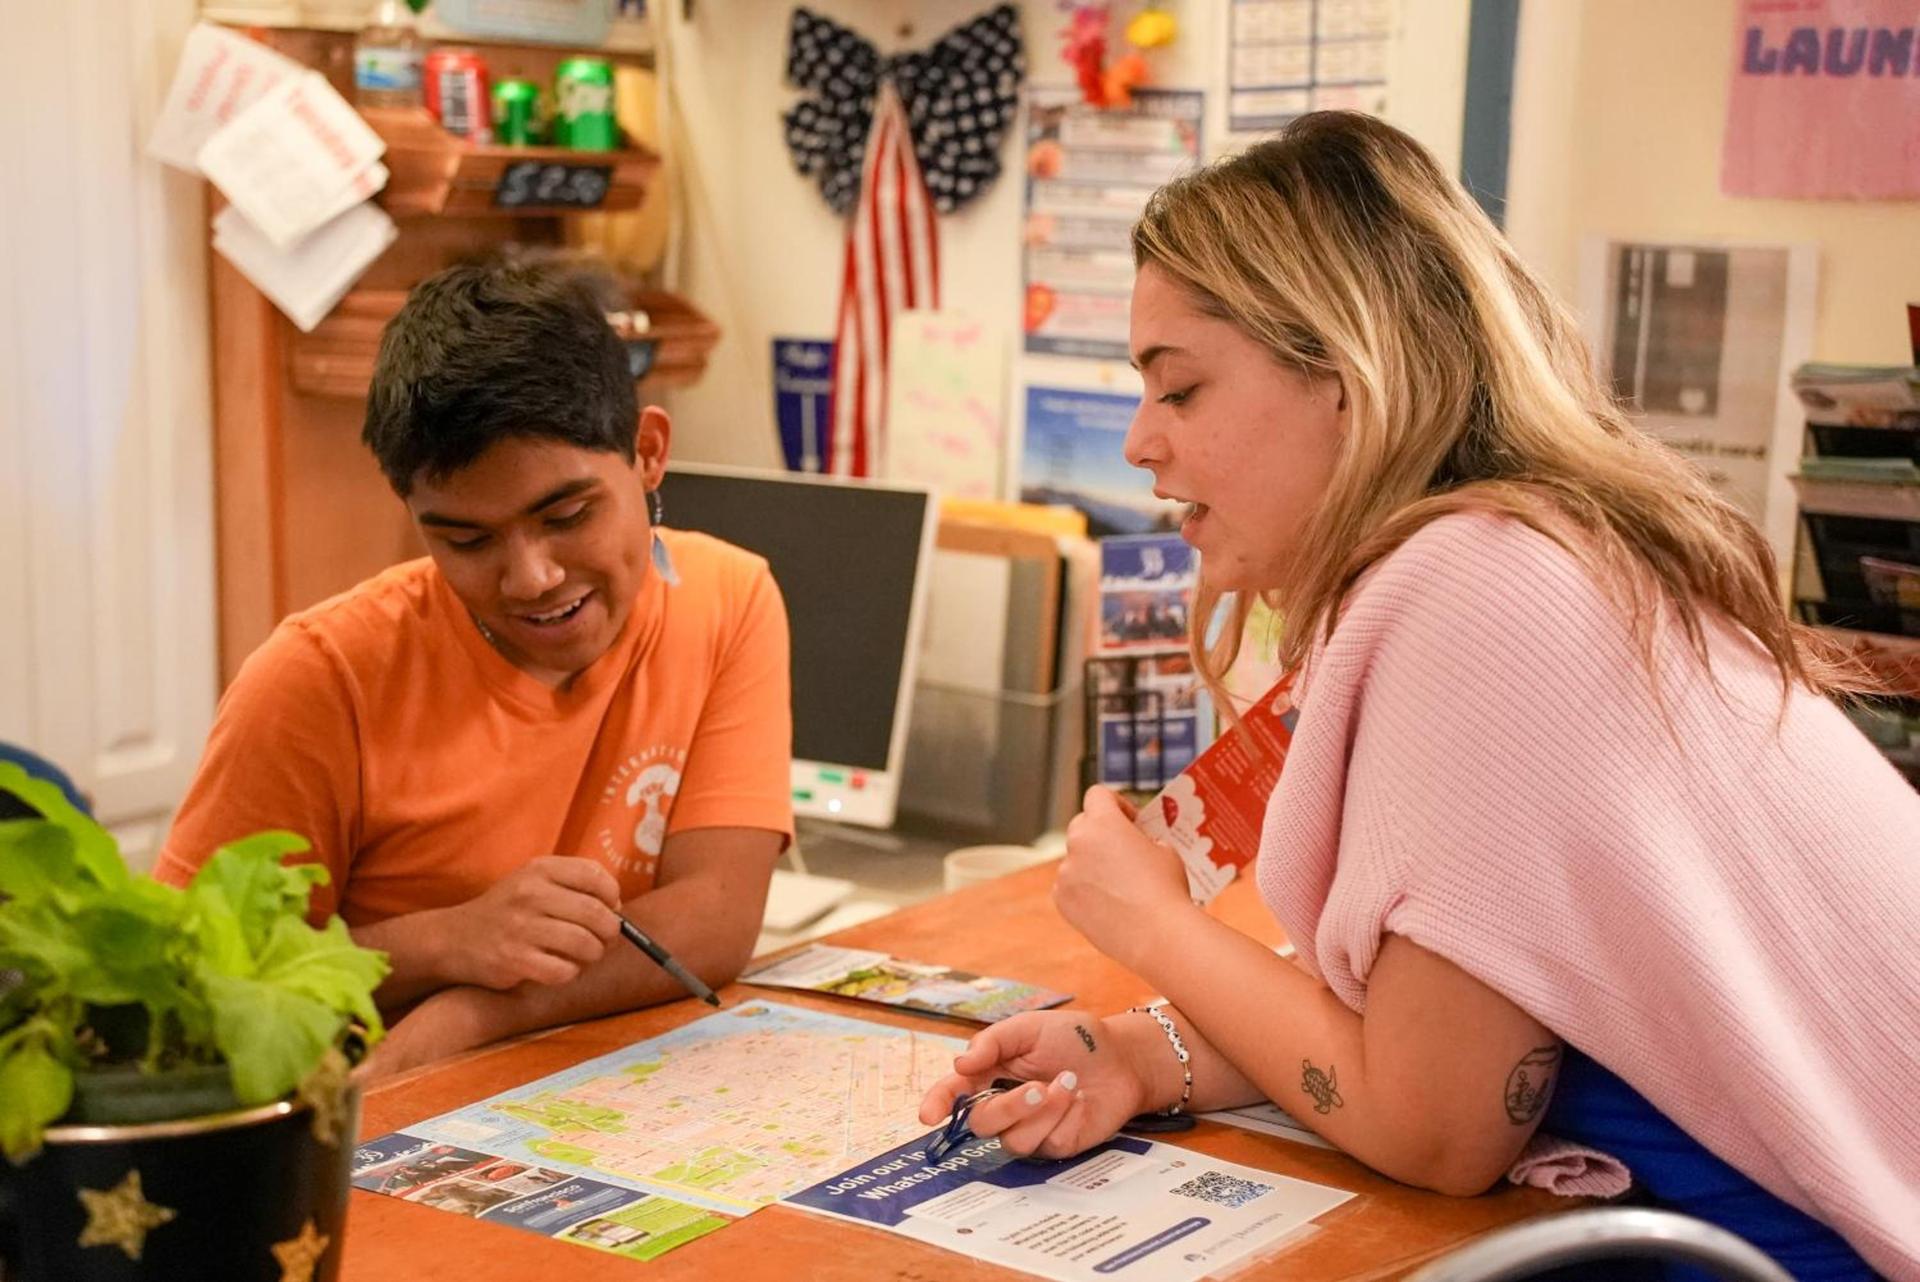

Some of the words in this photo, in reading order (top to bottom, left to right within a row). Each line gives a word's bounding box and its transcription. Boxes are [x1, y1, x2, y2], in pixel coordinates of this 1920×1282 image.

[1743, 27, 1920, 77] LAUN
[826, 1173, 876, 1196] Join
[872, 1158, 909, 1177] our
[902, 1149, 928, 1162] in
[857, 1156, 969, 1202] WhatsApp
[960, 1137, 1002, 1158] Gro
